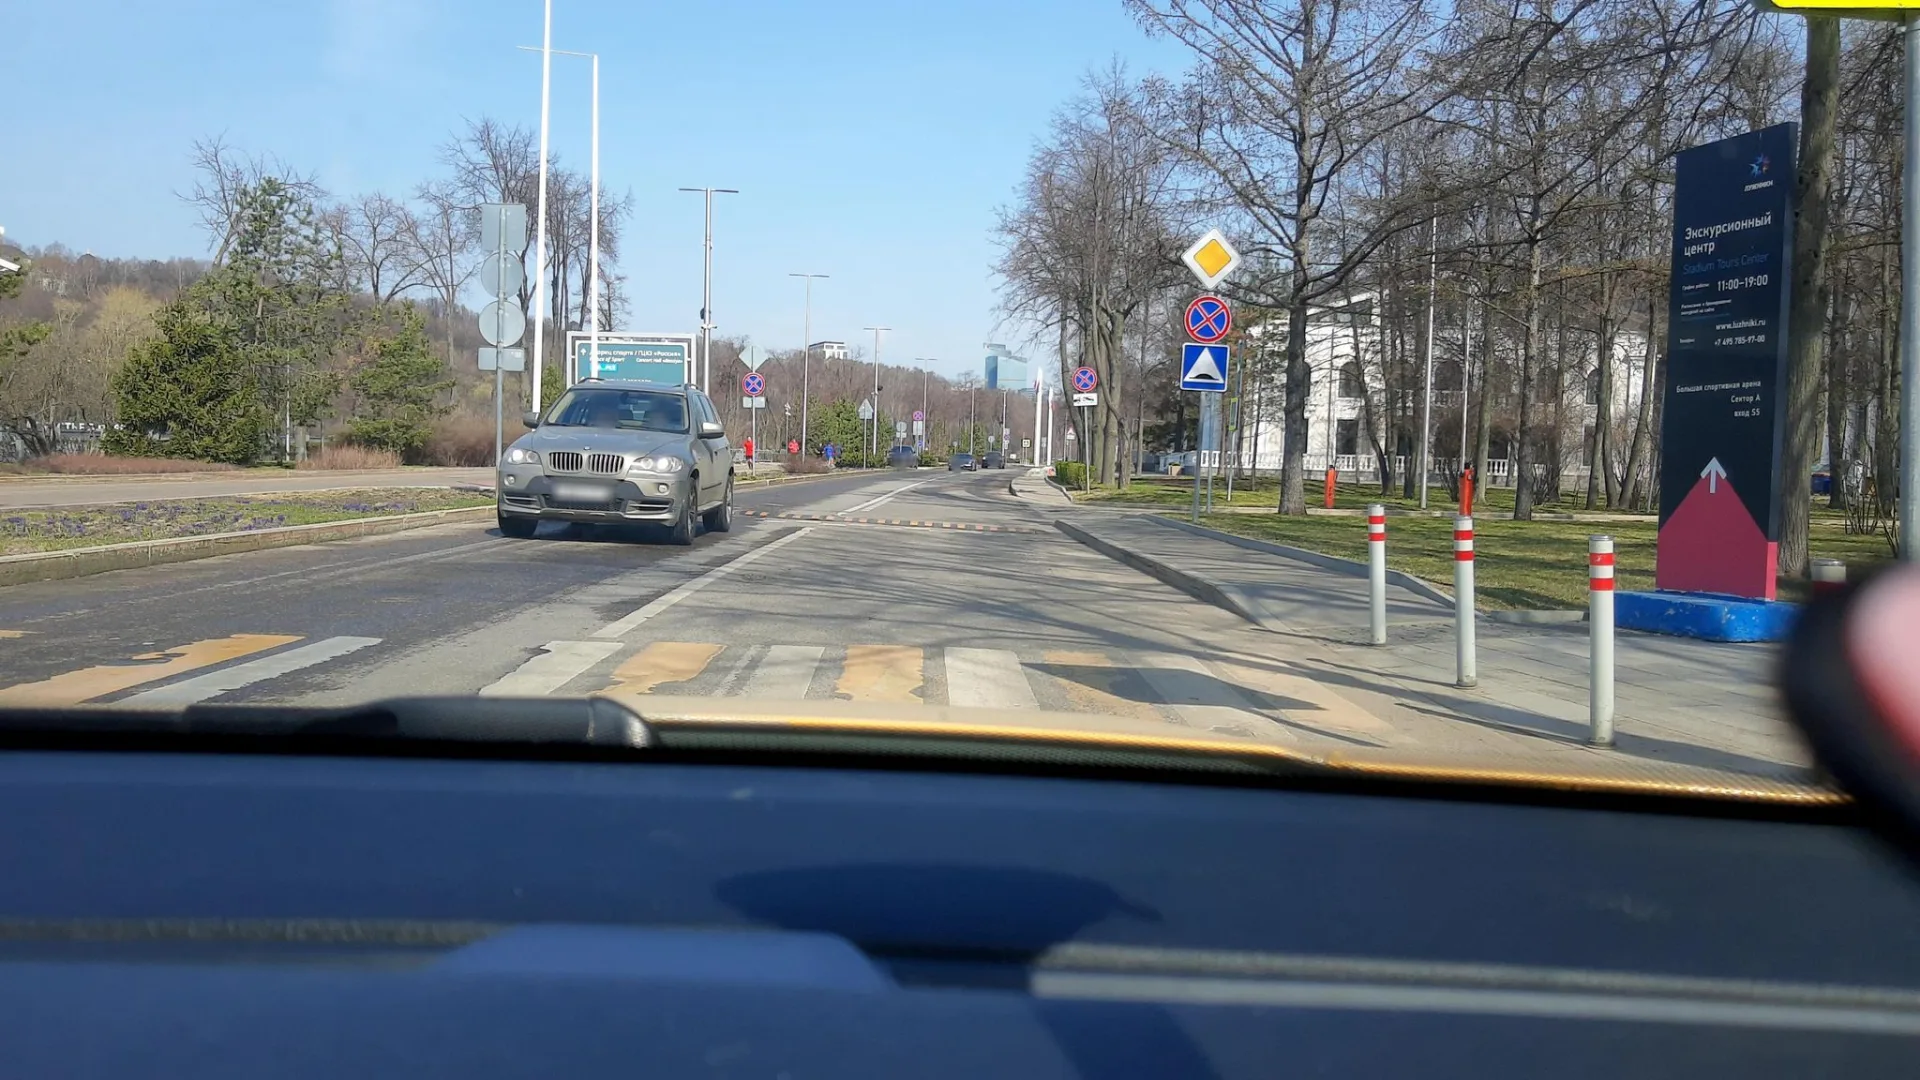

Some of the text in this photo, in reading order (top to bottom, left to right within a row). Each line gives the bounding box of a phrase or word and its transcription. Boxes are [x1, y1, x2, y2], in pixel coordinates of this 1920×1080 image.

[1684, 211, 1772, 240] Экскурсионный
[1684, 242, 1715, 257] центр
[1682, 253, 1769, 275] Stadium Tours Center
[1715, 319, 1766, 330] www.luzhniki.ru
[1722, 337, 1733, 346] 495
[1734, 335, 1765, 345] 785-97-00
[1676, 380, 1761, 393] Большая спортивная арена
[1730, 395, 1754, 403] Сектор
